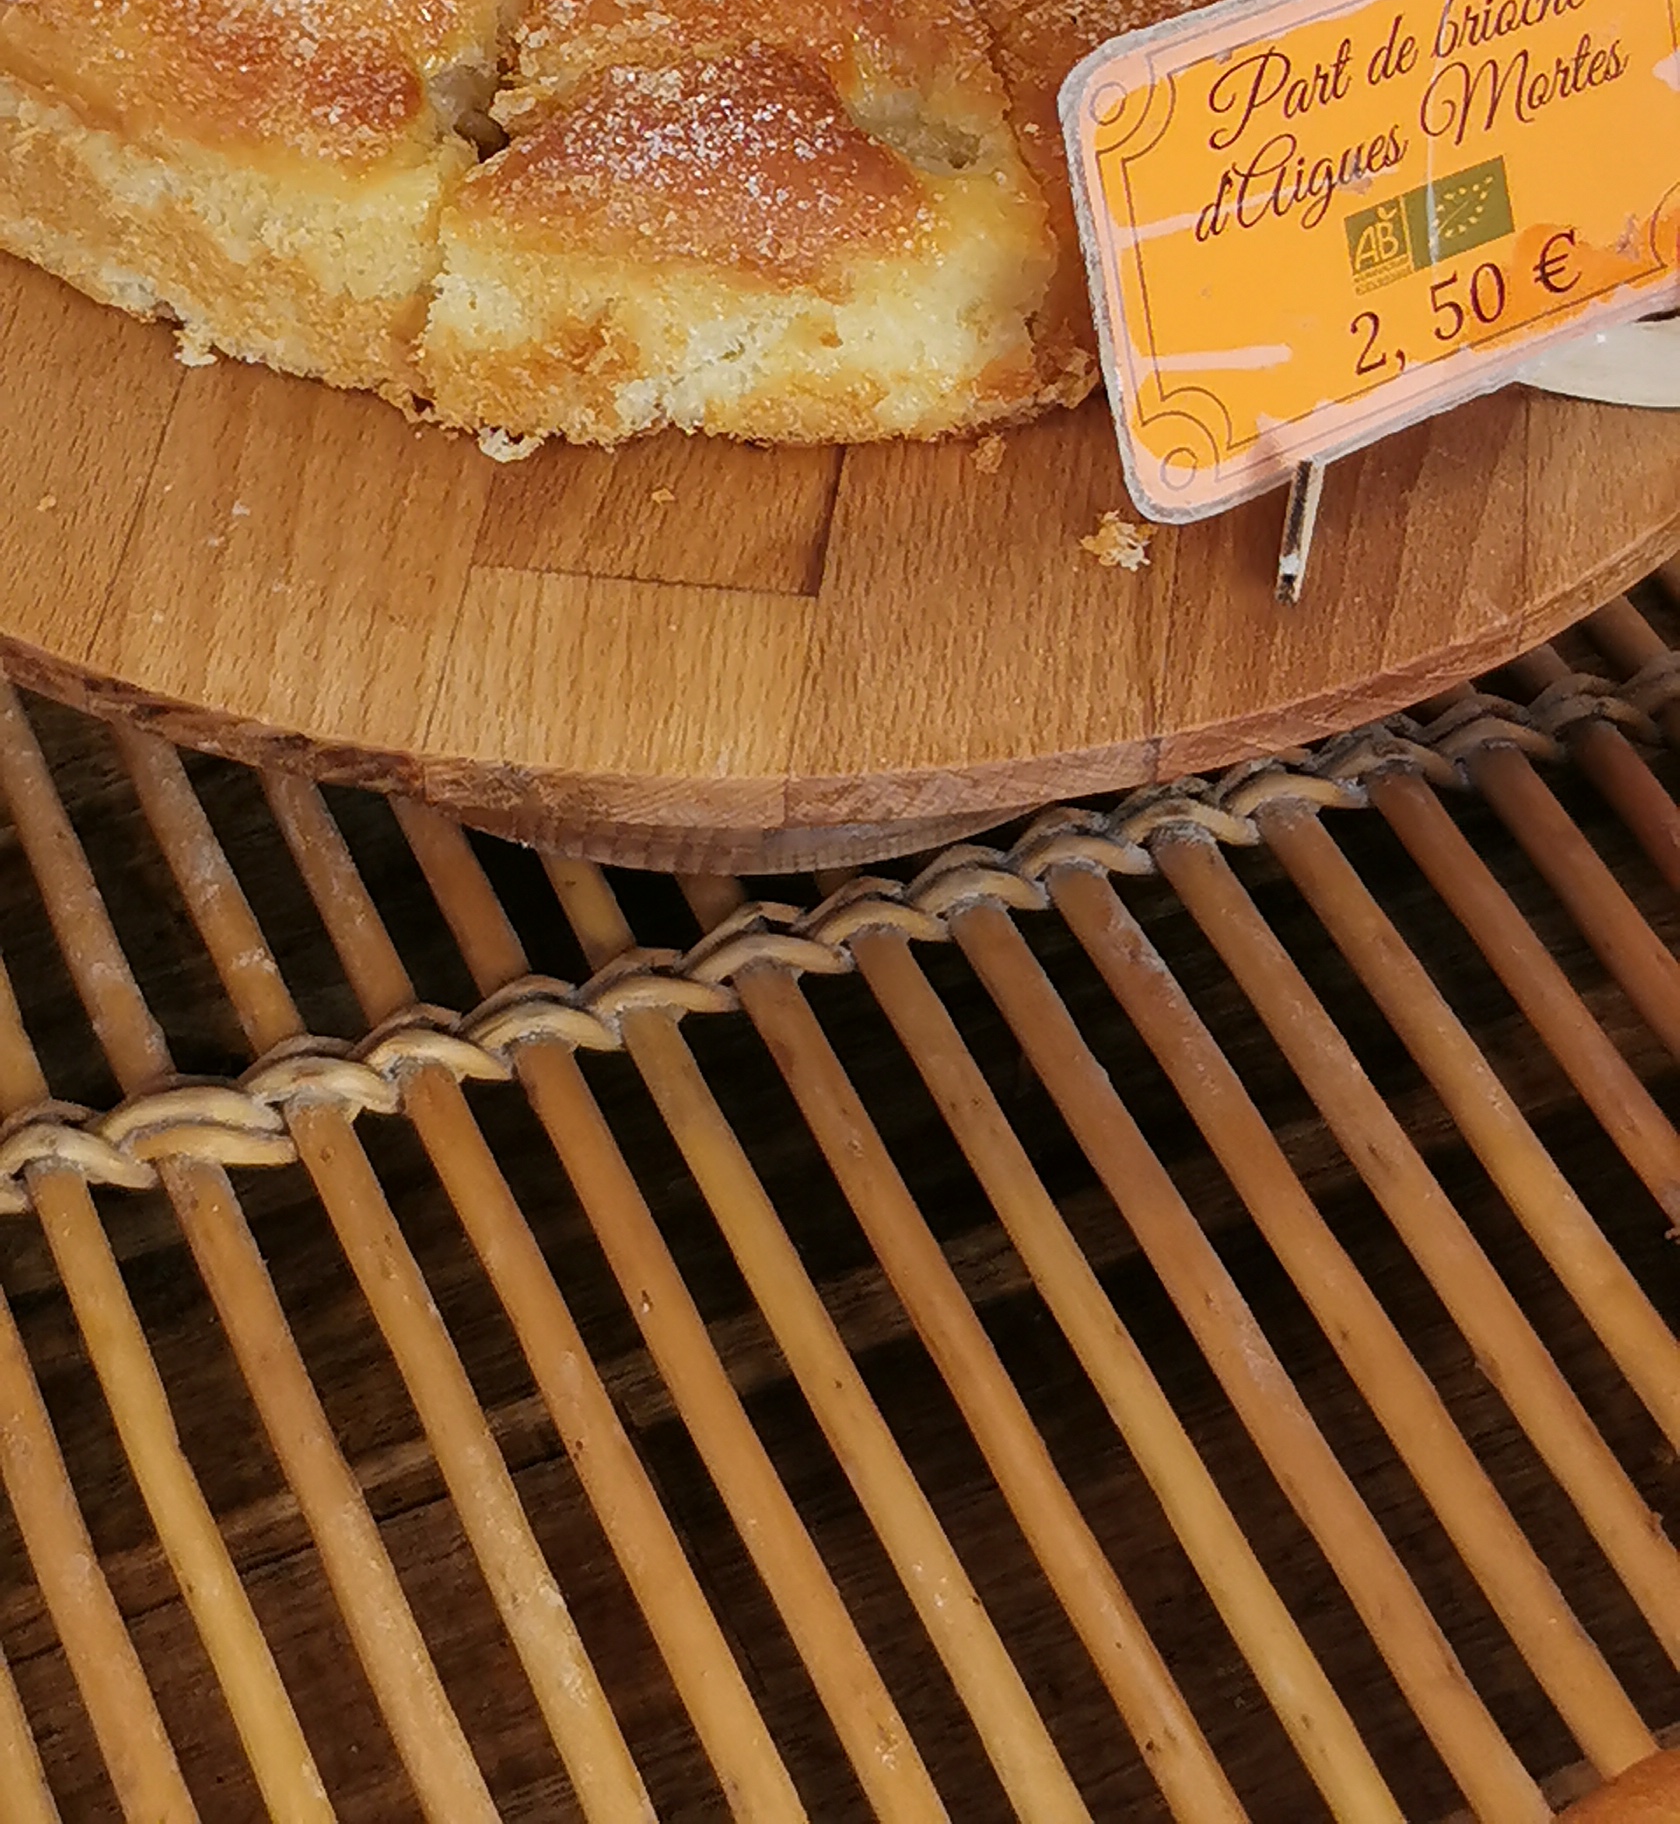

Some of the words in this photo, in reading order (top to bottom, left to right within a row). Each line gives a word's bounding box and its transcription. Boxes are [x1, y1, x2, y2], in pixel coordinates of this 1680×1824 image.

[1208, 37, 1353, 151] Part
[1367, 13, 1419, 86] de
[1419, 31, 1631, 147] Mortes
[1353, 219, 1400, 272] AB
[1531, 228, 1582, 294] €
